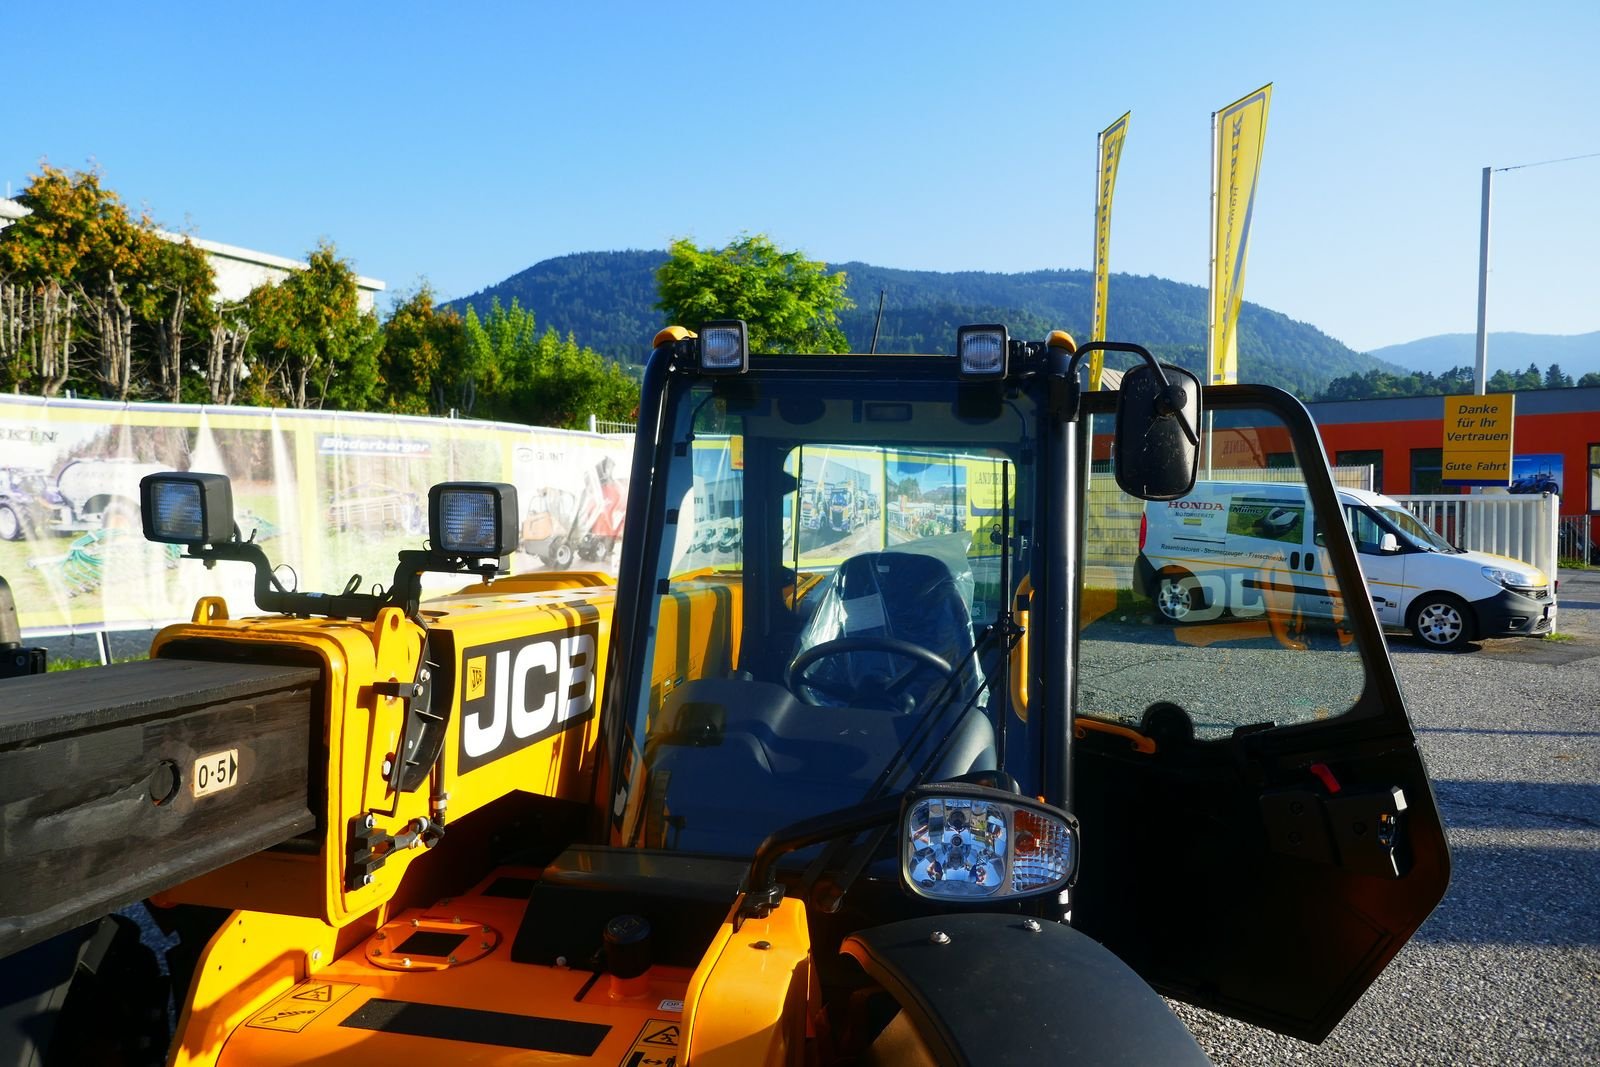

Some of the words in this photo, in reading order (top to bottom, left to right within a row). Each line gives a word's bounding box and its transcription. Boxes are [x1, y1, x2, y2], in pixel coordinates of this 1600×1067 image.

[1458, 404, 1498, 414] Danke
[1457, 417, 1475, 428] für
[1479, 418, 1497, 428] Ihr
[1447, 432, 1509, 441] Vertrauen
[321, 438, 430, 453] Binderberger
[1445, 462, 1472, 471] Gute
[1477, 462, 1507, 471] Fahrt
[1168, 501, 1224, 512] HONDA
[464, 634, 595, 758] JCB
